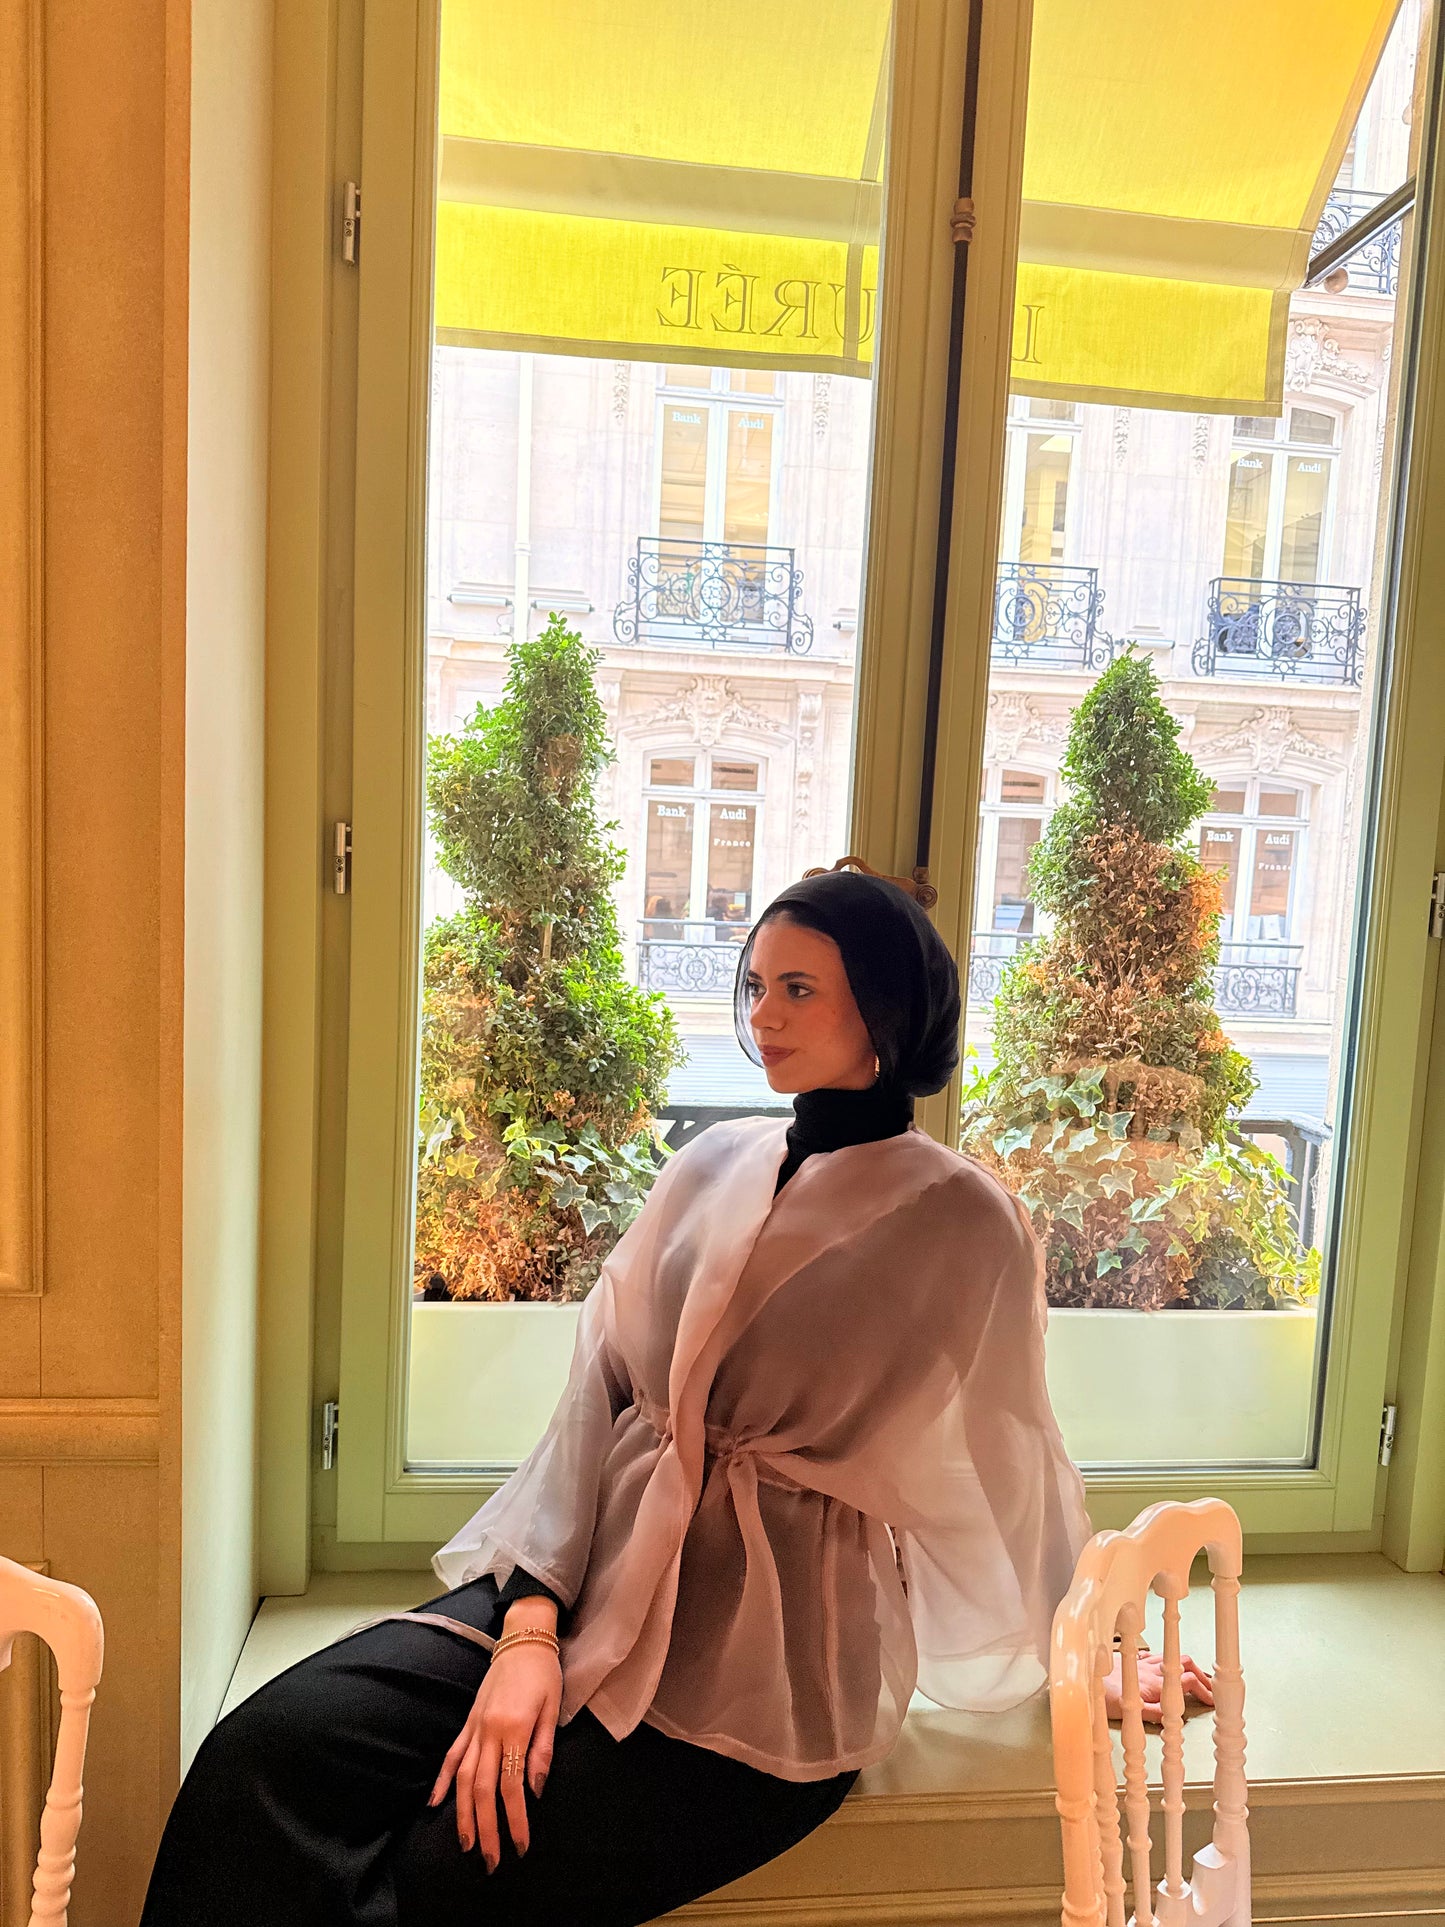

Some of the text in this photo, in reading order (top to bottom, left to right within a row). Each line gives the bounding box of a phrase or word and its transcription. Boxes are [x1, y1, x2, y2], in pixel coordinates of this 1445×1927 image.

[672, 411, 765, 429] Bank Audi
[1236, 457, 1322, 473] Bank Audi
[657, 805, 747, 820] Bank Audi
[1206, 830, 1290, 845] Bank Audi
